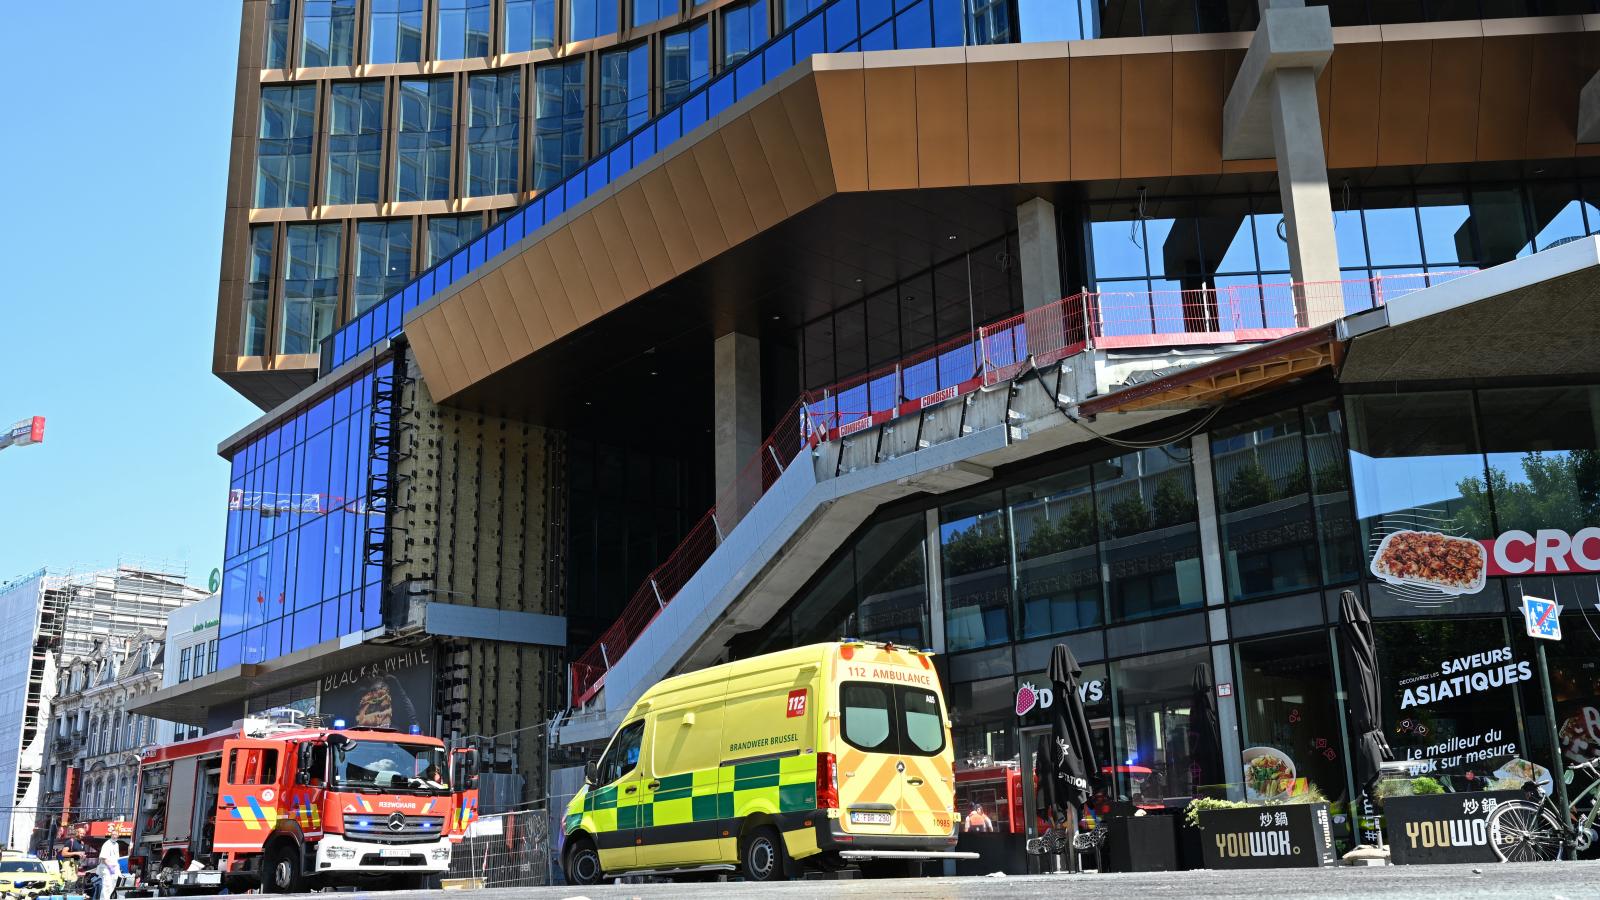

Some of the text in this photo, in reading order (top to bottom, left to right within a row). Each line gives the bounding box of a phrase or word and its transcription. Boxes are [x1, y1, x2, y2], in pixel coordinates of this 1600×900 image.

[922, 386, 955, 407] COMBISAFE
[840, 417, 870, 435] COMBISAFE
[324, 666, 367, 692] BLACK
[384, 648, 430, 673] WHITE
[1441, 646, 1513, 675] SAVEURS
[848, 667, 931, 686] 112 AMBULANCE
[1400, 661, 1533, 710] ASIATIQUES
[788, 695, 806, 711] 112
[730, 733, 799, 752] BRANDWEER BRUSSEL
[1407, 728, 1502, 761] Le meilleur du
[1409, 742, 1516, 777] wok sur mesure
[933, 818, 950, 828] 10985
